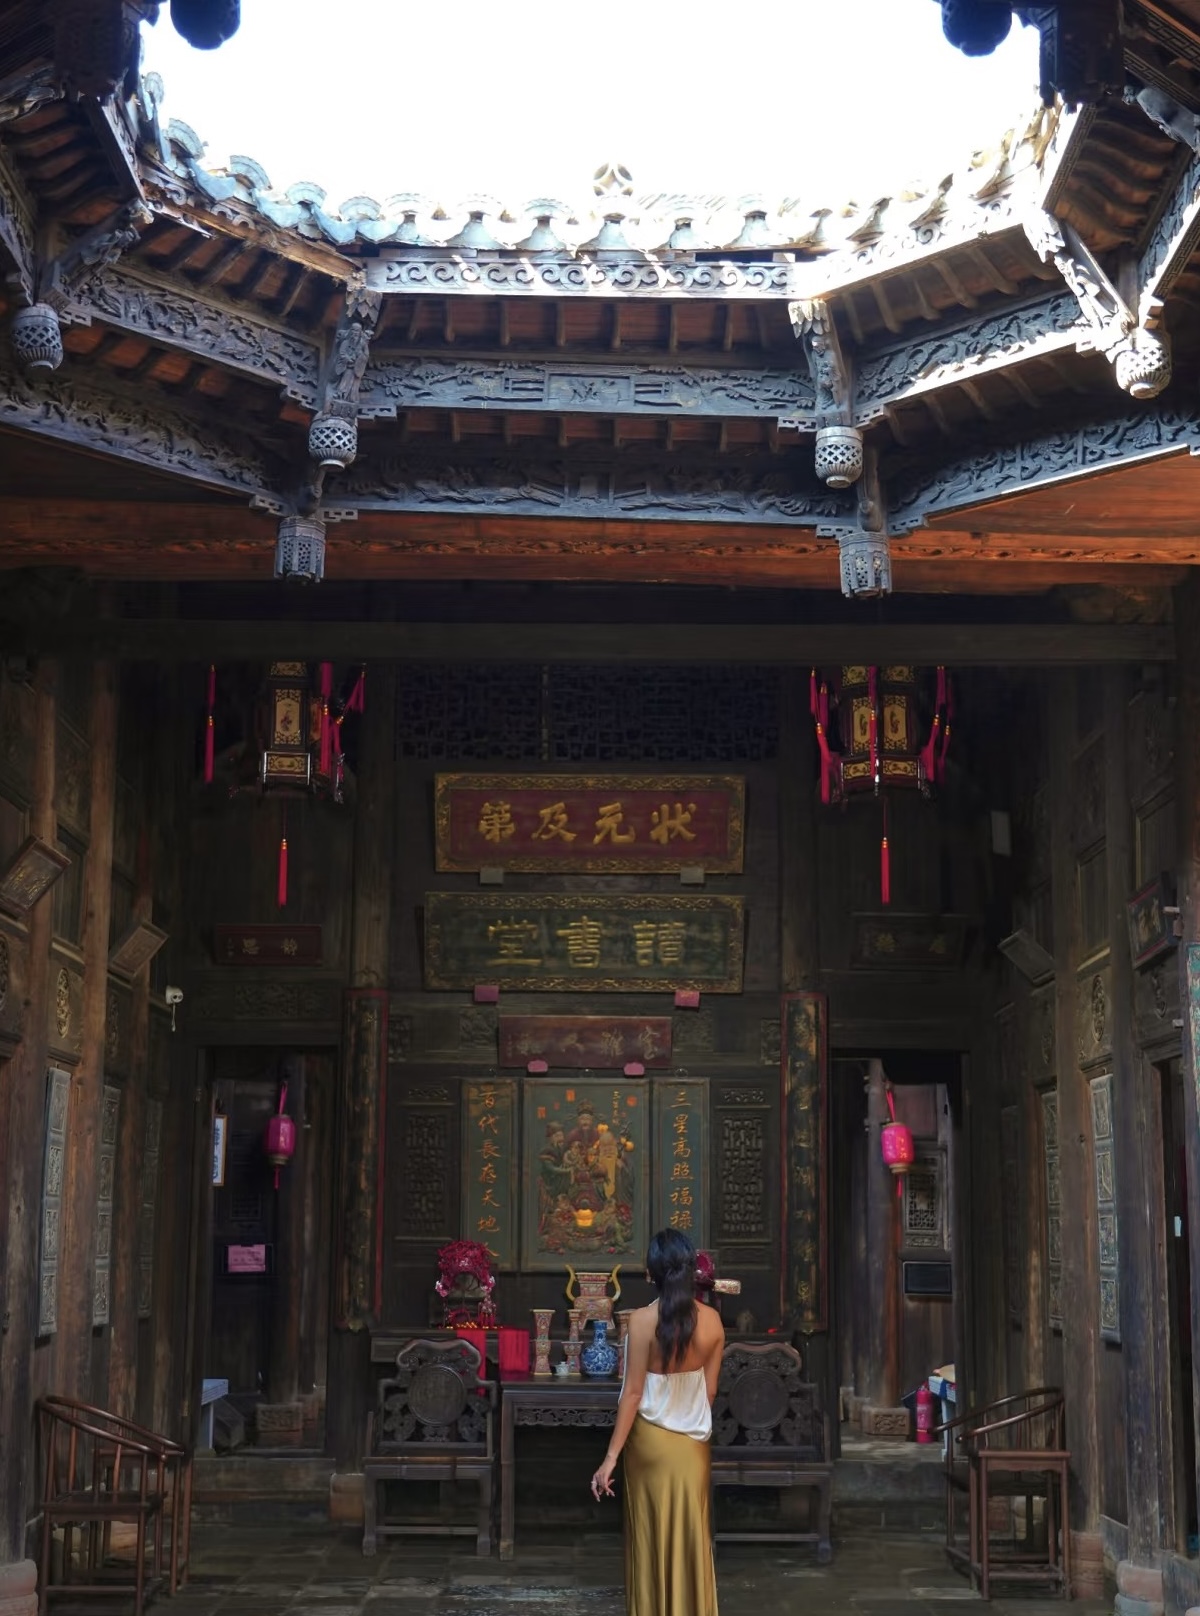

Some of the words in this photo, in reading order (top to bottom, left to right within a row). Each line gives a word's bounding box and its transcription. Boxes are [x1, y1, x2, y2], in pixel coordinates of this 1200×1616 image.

[478, 801, 698, 845] 状元及第
[485, 915, 687, 968] 讀書堂
